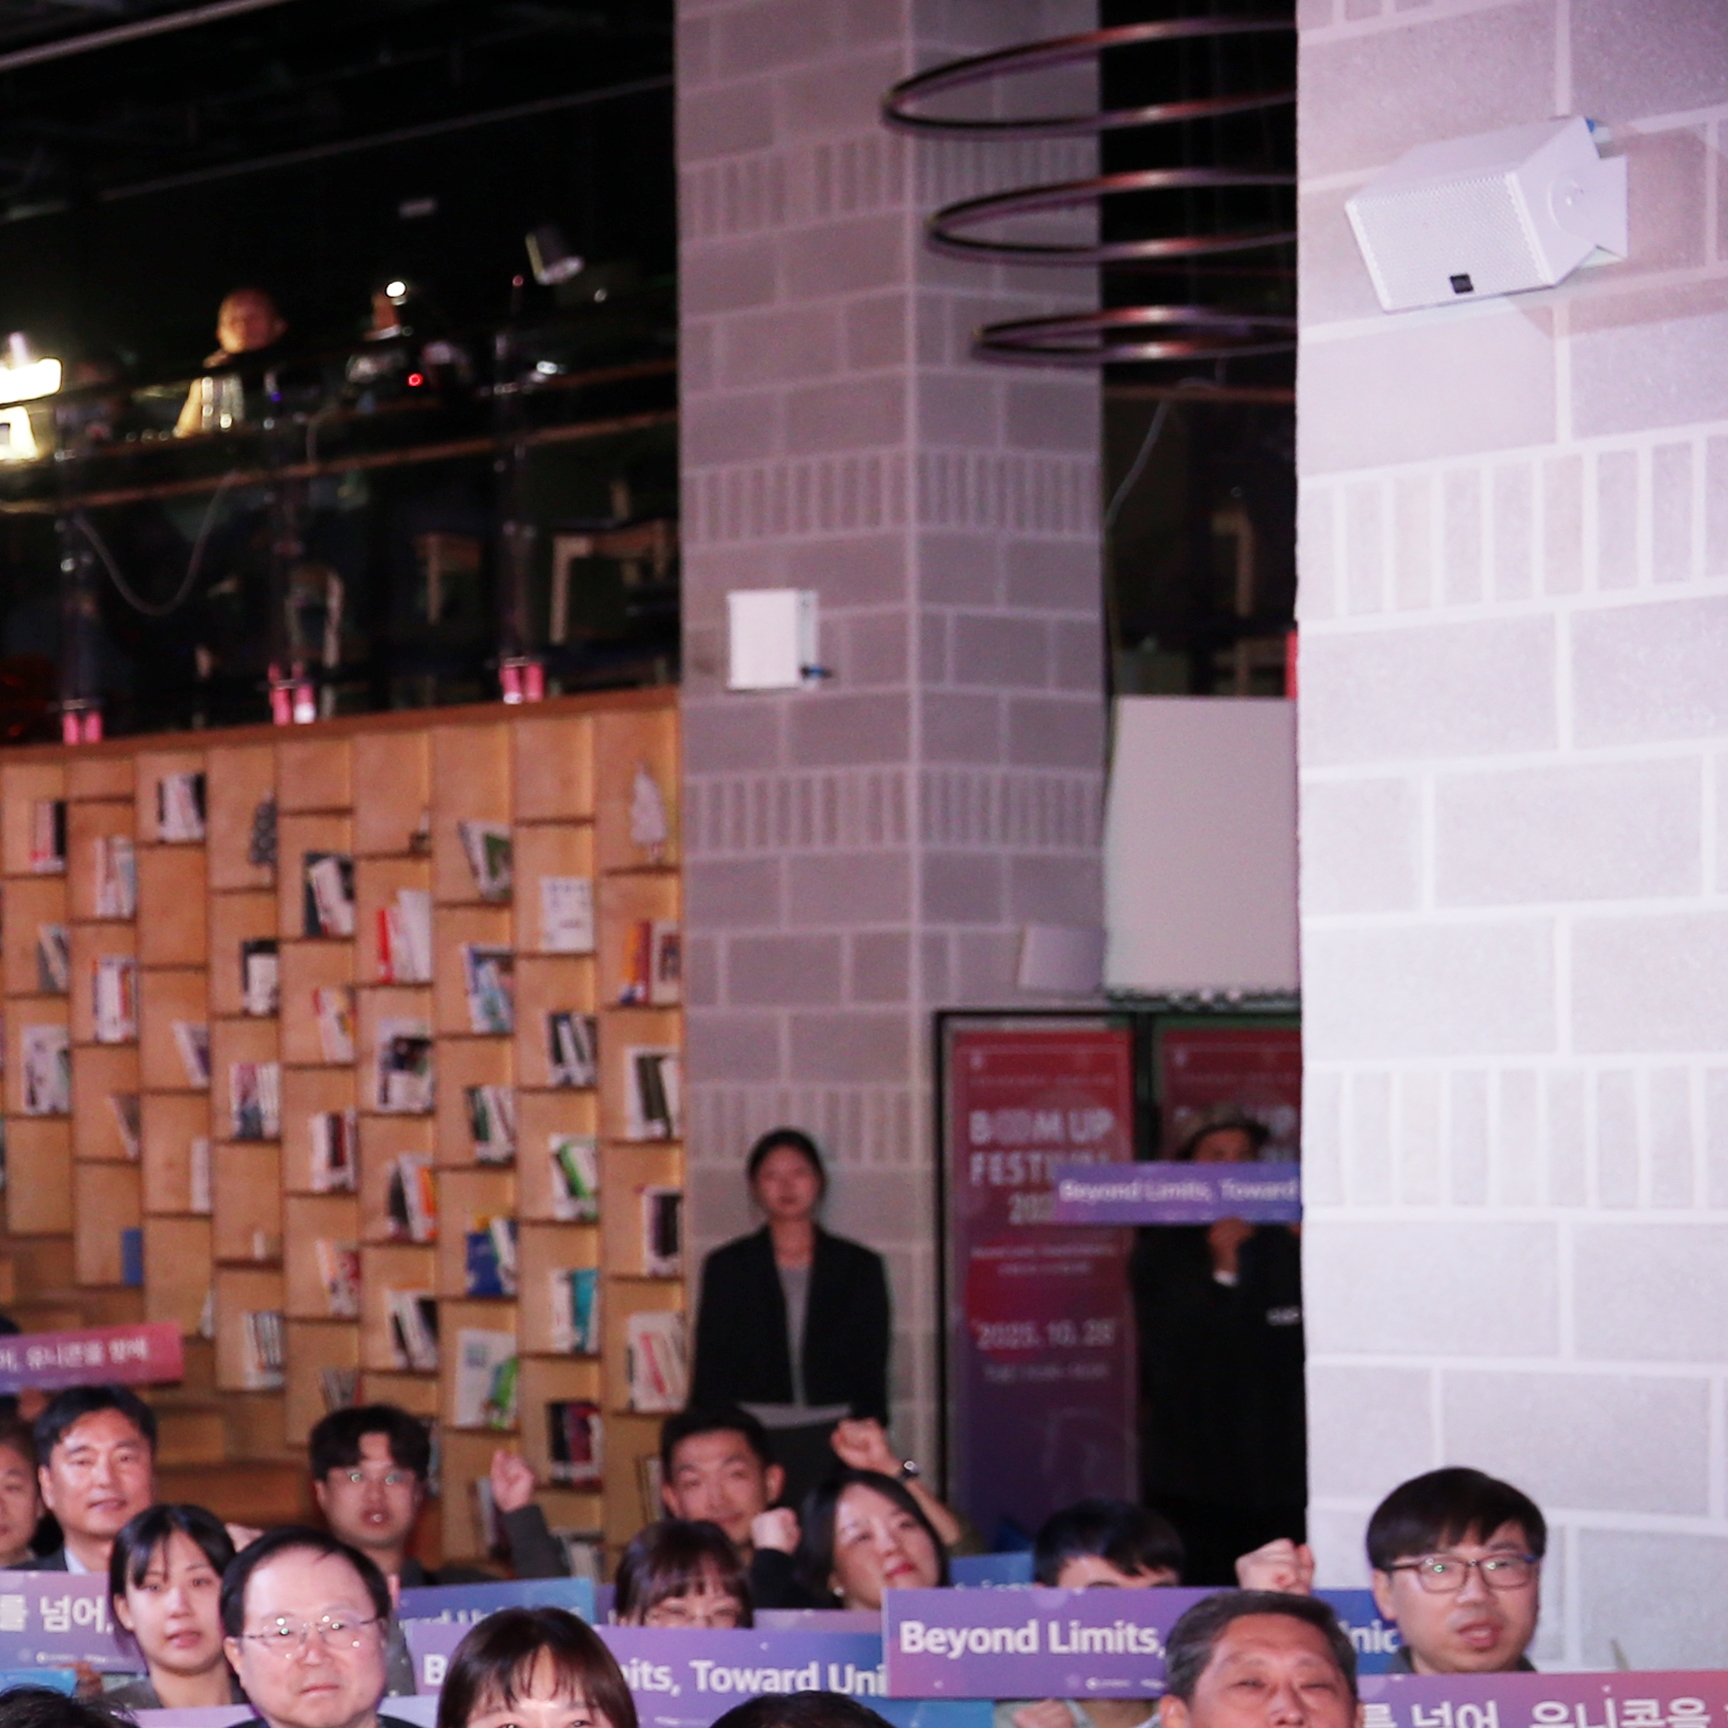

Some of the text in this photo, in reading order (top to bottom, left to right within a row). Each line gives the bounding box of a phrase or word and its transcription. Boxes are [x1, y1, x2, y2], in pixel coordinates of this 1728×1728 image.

[39, 1596, 115, 1634] 넘어,
[900, 1619, 1166, 1661] Beyond Limits,
[690, 1659, 820, 1694] Toward
